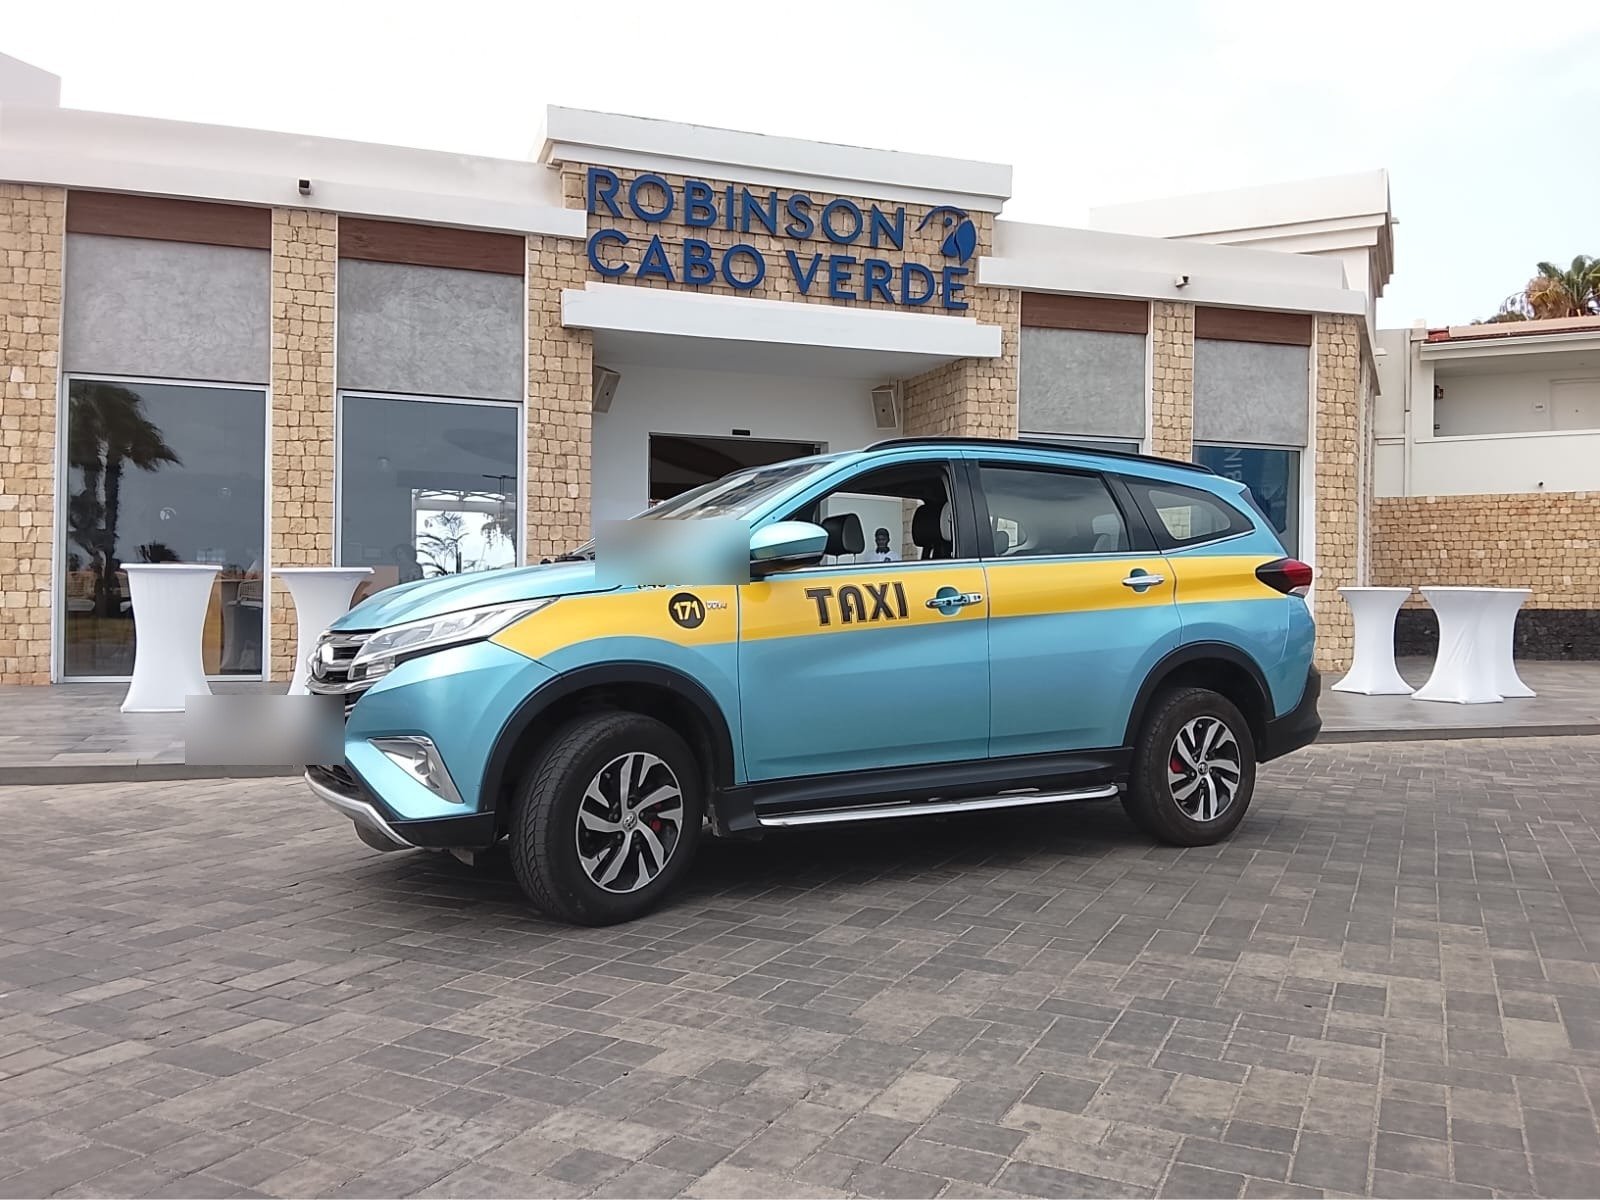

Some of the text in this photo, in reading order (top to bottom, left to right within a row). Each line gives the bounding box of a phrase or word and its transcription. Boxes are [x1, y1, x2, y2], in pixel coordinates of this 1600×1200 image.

[587, 167, 904, 250] ROBINSON
[588, 229, 969, 310] CABO VERDE
[673, 600, 701, 620] 171
[805, 581, 909, 626] TAXI
